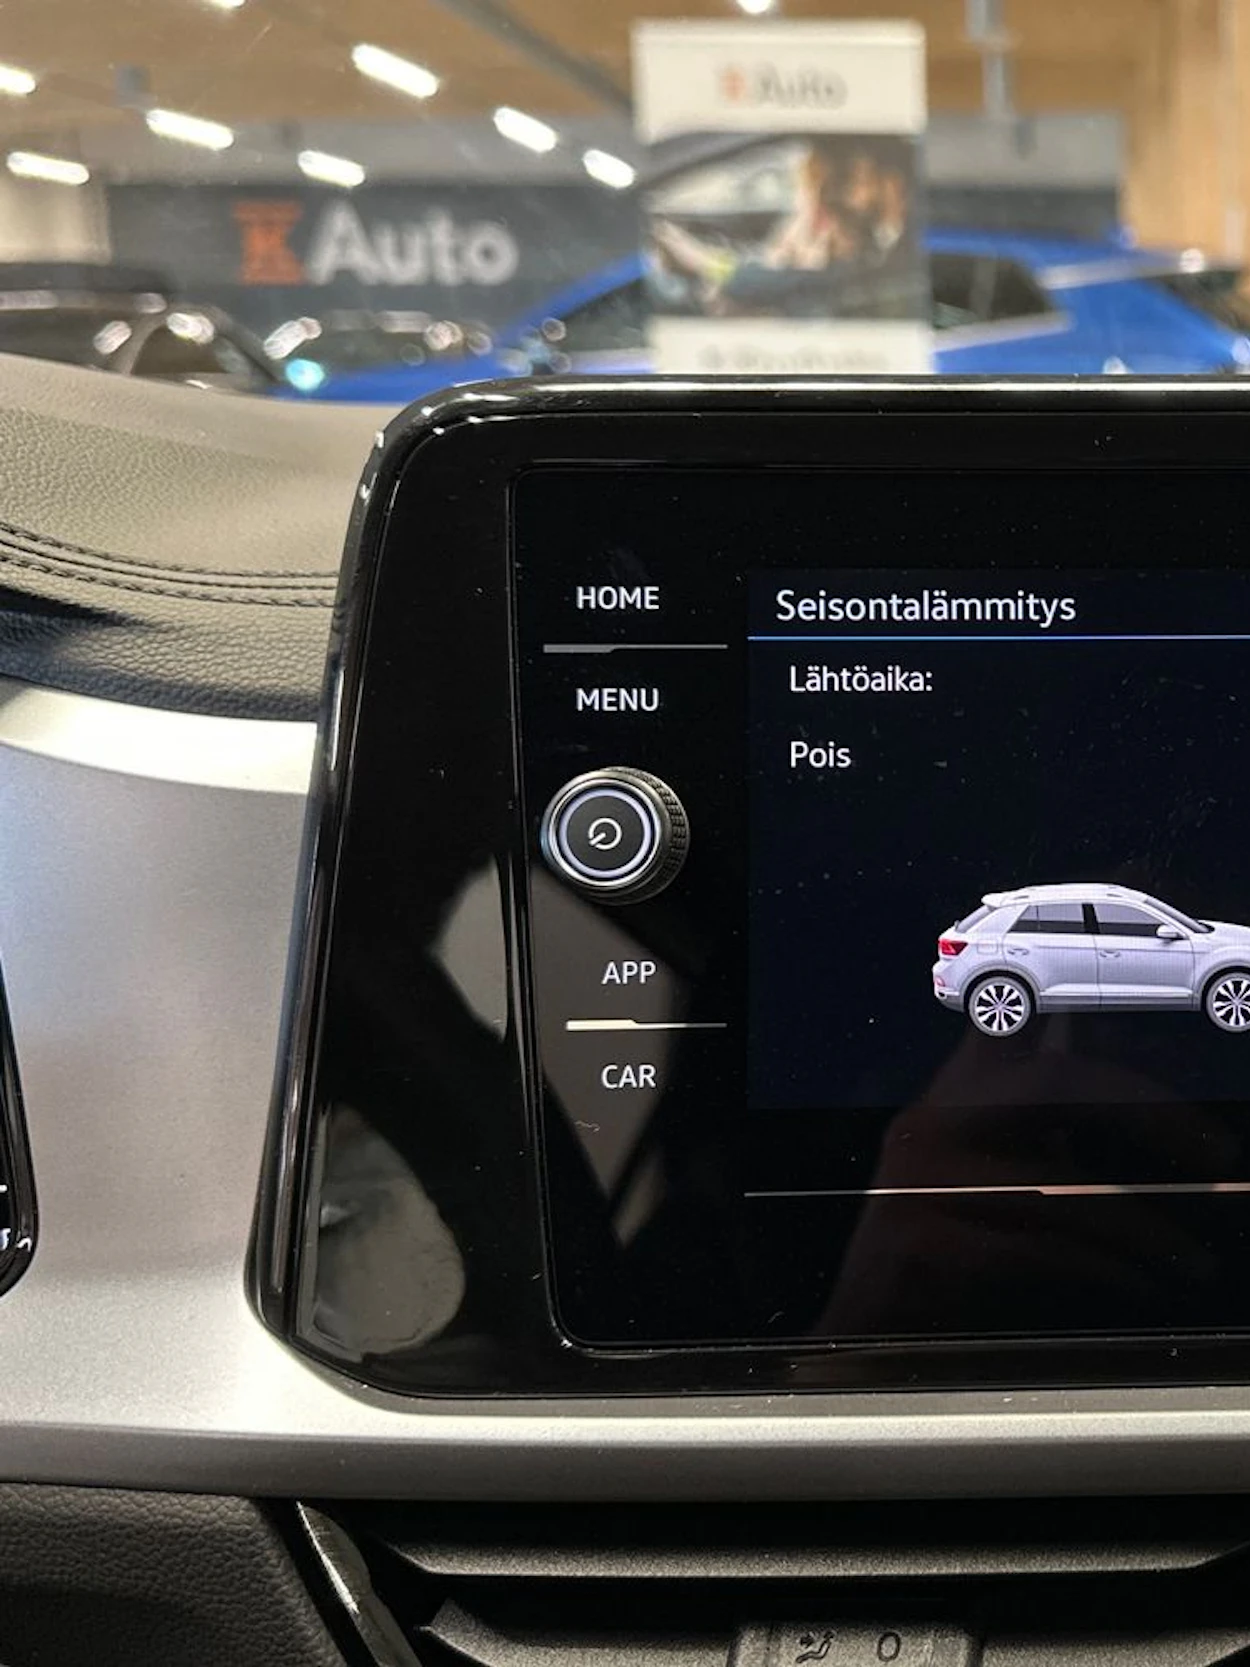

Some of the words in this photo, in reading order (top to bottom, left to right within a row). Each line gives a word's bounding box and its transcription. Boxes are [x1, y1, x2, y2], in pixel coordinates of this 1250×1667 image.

[308, 201, 519, 287] Auto
[576, 585, 660, 611] HOME
[776, 589, 1076, 625] Seisontalämmitys
[789, 664, 933, 692] Lähtöaika:
[576, 687, 659, 712] MENU
[789, 741, 852, 768] Pois
[601, 960, 657, 985] APP
[601, 1064, 657, 1090] CAR
